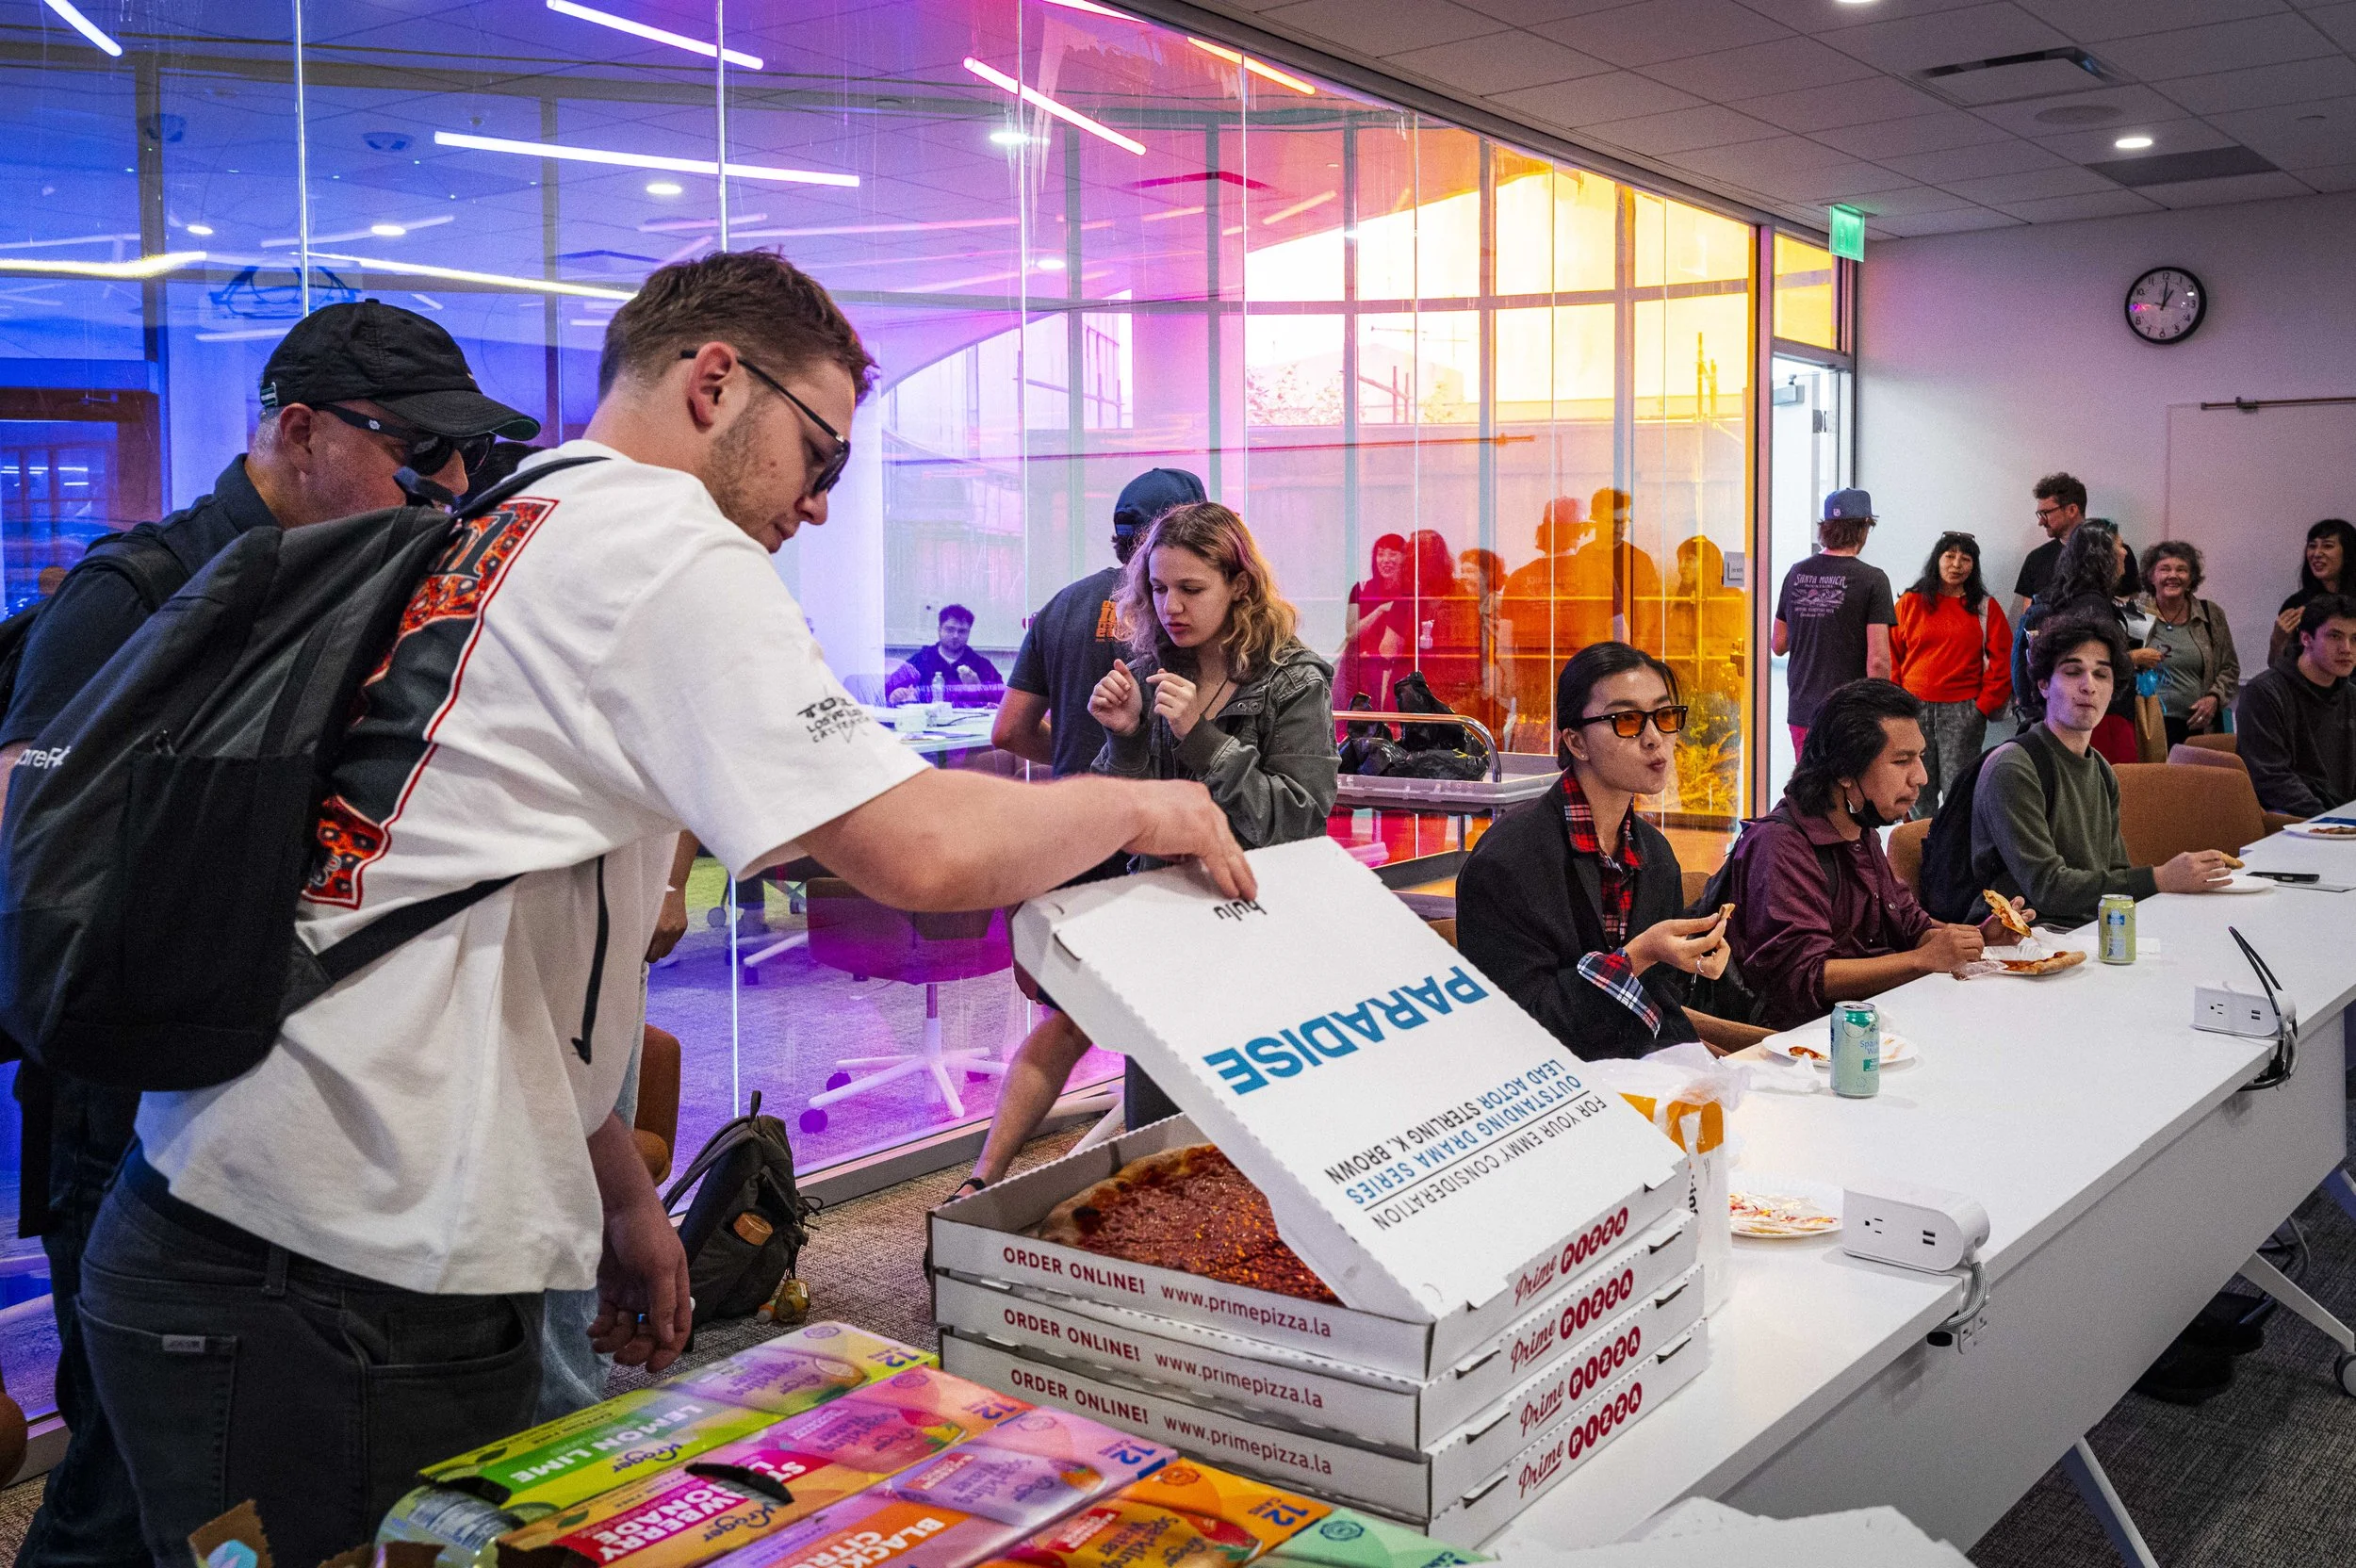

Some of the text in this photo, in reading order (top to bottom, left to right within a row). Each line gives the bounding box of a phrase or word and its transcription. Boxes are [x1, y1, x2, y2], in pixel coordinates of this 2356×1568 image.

[2163, 272, 2170, 281] 12
[1794, 574, 1848, 588] SANTA MONICA
[1213, 899, 1268, 922] hulu
[1203, 966, 1490, 1095] PARADISE
[1324, 1058, 1565, 1184] LEAD ACTOR STERLING K. BROWN
[1539, 1112, 1581, 1138] YOUR
[1577, 1096, 1607, 1119] FOR
[1346, 1075, 1581, 1204] OUTSTANDING DRAMA SERIES
[1371, 1154, 1500, 1231] CONSIDERATION
[1514, 1206, 1628, 1307] Prime PIZZA
[1004, 1247, 1331, 1337] ORDER ONLINE! www.primepizza.la
[1511, 1268, 1633, 1374] Prime PIZZA
[877, 1349, 920, 1367] 12
[1004, 1309, 1323, 1408] ORDER ONLINE! www.primepizza.la
[1520, 1326, 1641, 1437] Prime PIZZA
[591, 1404, 704, 1451] LEMON
[973, 1401, 1018, 1420] 12
[1011, 1369, 1333, 1475] ORDER ONLINE! www.primepizza.la
[613, 1443, 683, 1474] Kroger
[1109, 1445, 1155, 1464] 12
[1518, 1382, 1642, 1499] Prime PIZZA
[510, 1448, 594, 1484] LIME
[592, 1461, 775, 1545] LONADE
[598, 1462, 807, 1561] STWBERRY
[703, 1502, 777, 1543] Kroger
[1248, 1496, 1309, 1527] 12 CANS
[791, 1530, 883, 1568] CITR
[828, 1516, 945, 1568] BLACK
